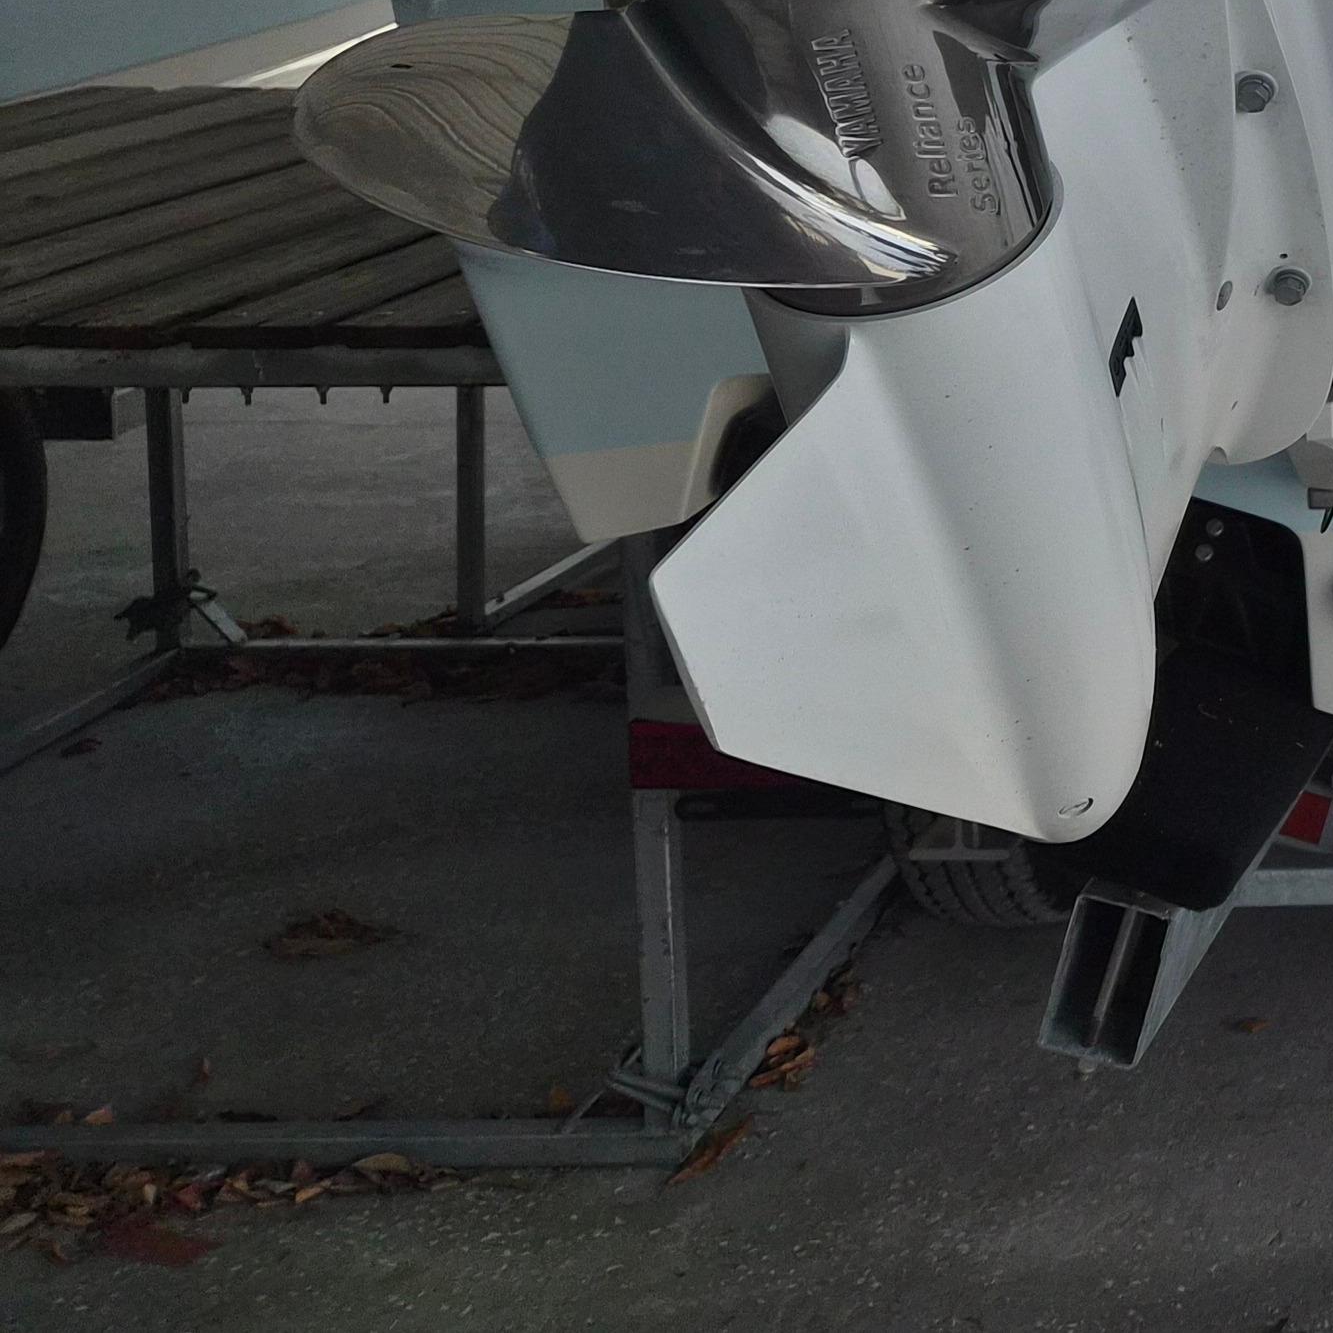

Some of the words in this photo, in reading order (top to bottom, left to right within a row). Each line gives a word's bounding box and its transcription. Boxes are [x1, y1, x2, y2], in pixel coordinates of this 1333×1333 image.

[810, 28, 883, 157] YAMAHA
[904, 63, 959, 199] Reliance
[955, 116, 999, 216] Series
